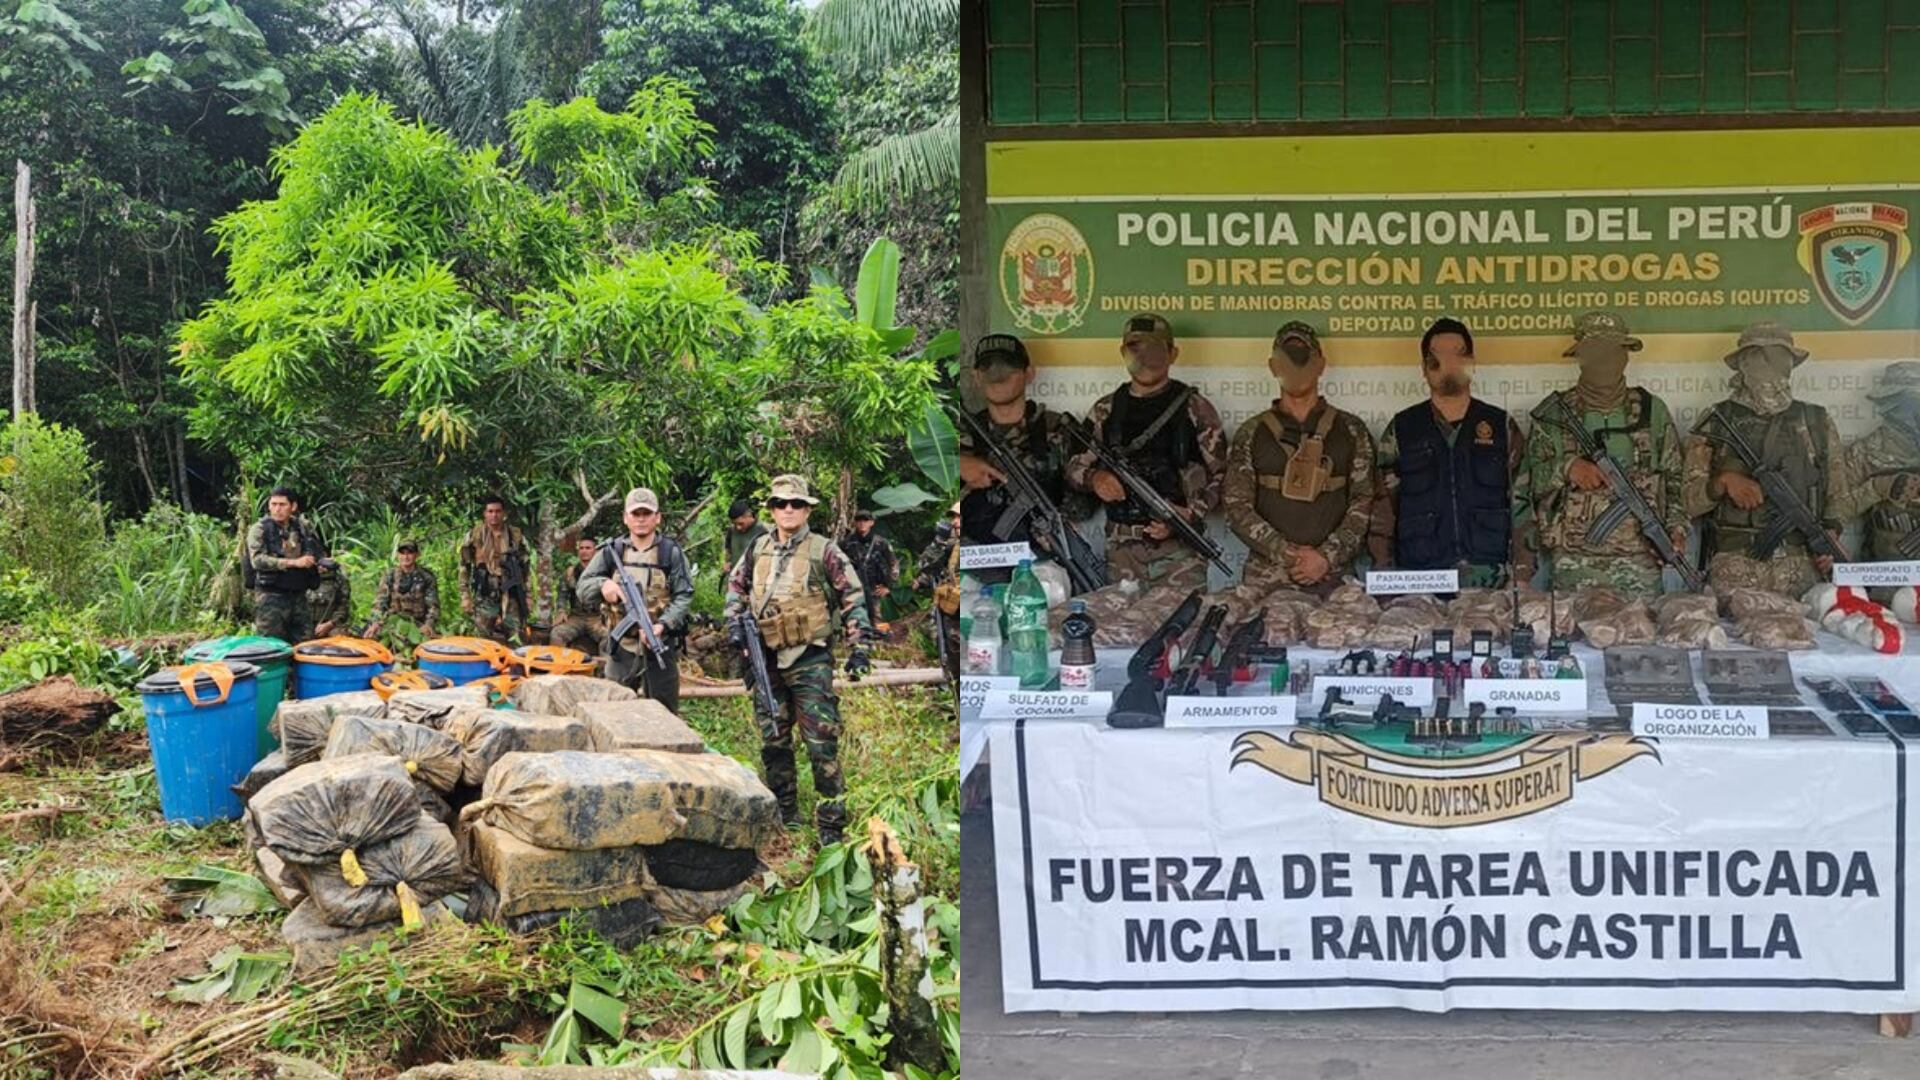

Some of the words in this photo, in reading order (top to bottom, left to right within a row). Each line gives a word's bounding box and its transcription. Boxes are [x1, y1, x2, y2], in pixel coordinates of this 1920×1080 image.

[1118, 211, 1299, 246] POLICIA
[1314, 207, 1549, 246] NACIONAL
[1566, 206, 1652, 243] DEL
[1668, 196, 1792, 241] PERÚ
[1187, 251, 1425, 286] DIRECCIÓN
[1435, 252, 1721, 284] ANTIDROGAS
[1100, 292, 1185, 311] DIVISIÓN
[1190, 296, 1215, 311] DE
[1220, 295, 1333, 311] MANIOBRAS
[1338, 295, 1417, 311] CONTRA
[1422, 294, 1446, 310] EL
[1451, 290, 1534, 309] TRÁFICO
[1539, 289, 1609, 308] ILÍCITO
[1614, 291, 1640, 307] DE
[1645, 290, 1725, 306] DROGAS
[1730, 288, 1811, 306] IQUITOS
[1329, 316, 1415, 332] DEPOTAD
[1421, 314, 1575, 332] CALLOCOCHA
[1340, 685, 1414, 696] UNICIONES
[1489, 690, 1561, 701] GRANADAS
[1008, 694, 1068, 706] SULFATO
[1070, 695, 1089, 705] DE
[1014, 707, 1076, 715] COCAINA
[1182, 704, 1278, 718] ARMAMENTOS
[1655, 708, 1698, 720] LOGO
[1702, 709, 1720, 720] DE
[1725, 709, 1745, 720] LA
[1644, 722, 1757, 736] ORGANIZACIÓN
[1327, 766, 1417, 816] FORTITUDO
[1421, 783, 1490, 817] ADVERSA
[1494, 763, 1562, 809] SUPERAT
[1048, 856, 1264, 903] FUERZA
[1282, 853, 1353, 899] DE
[1369, 852, 1551, 899] TAREA
[1569, 850, 1880, 897] UNIFICADA
[1125, 917, 1291, 963] MCAL.
[1311, 903, 1507, 962] RAMÓN
[1527, 914, 1803, 960] CASTILLA
